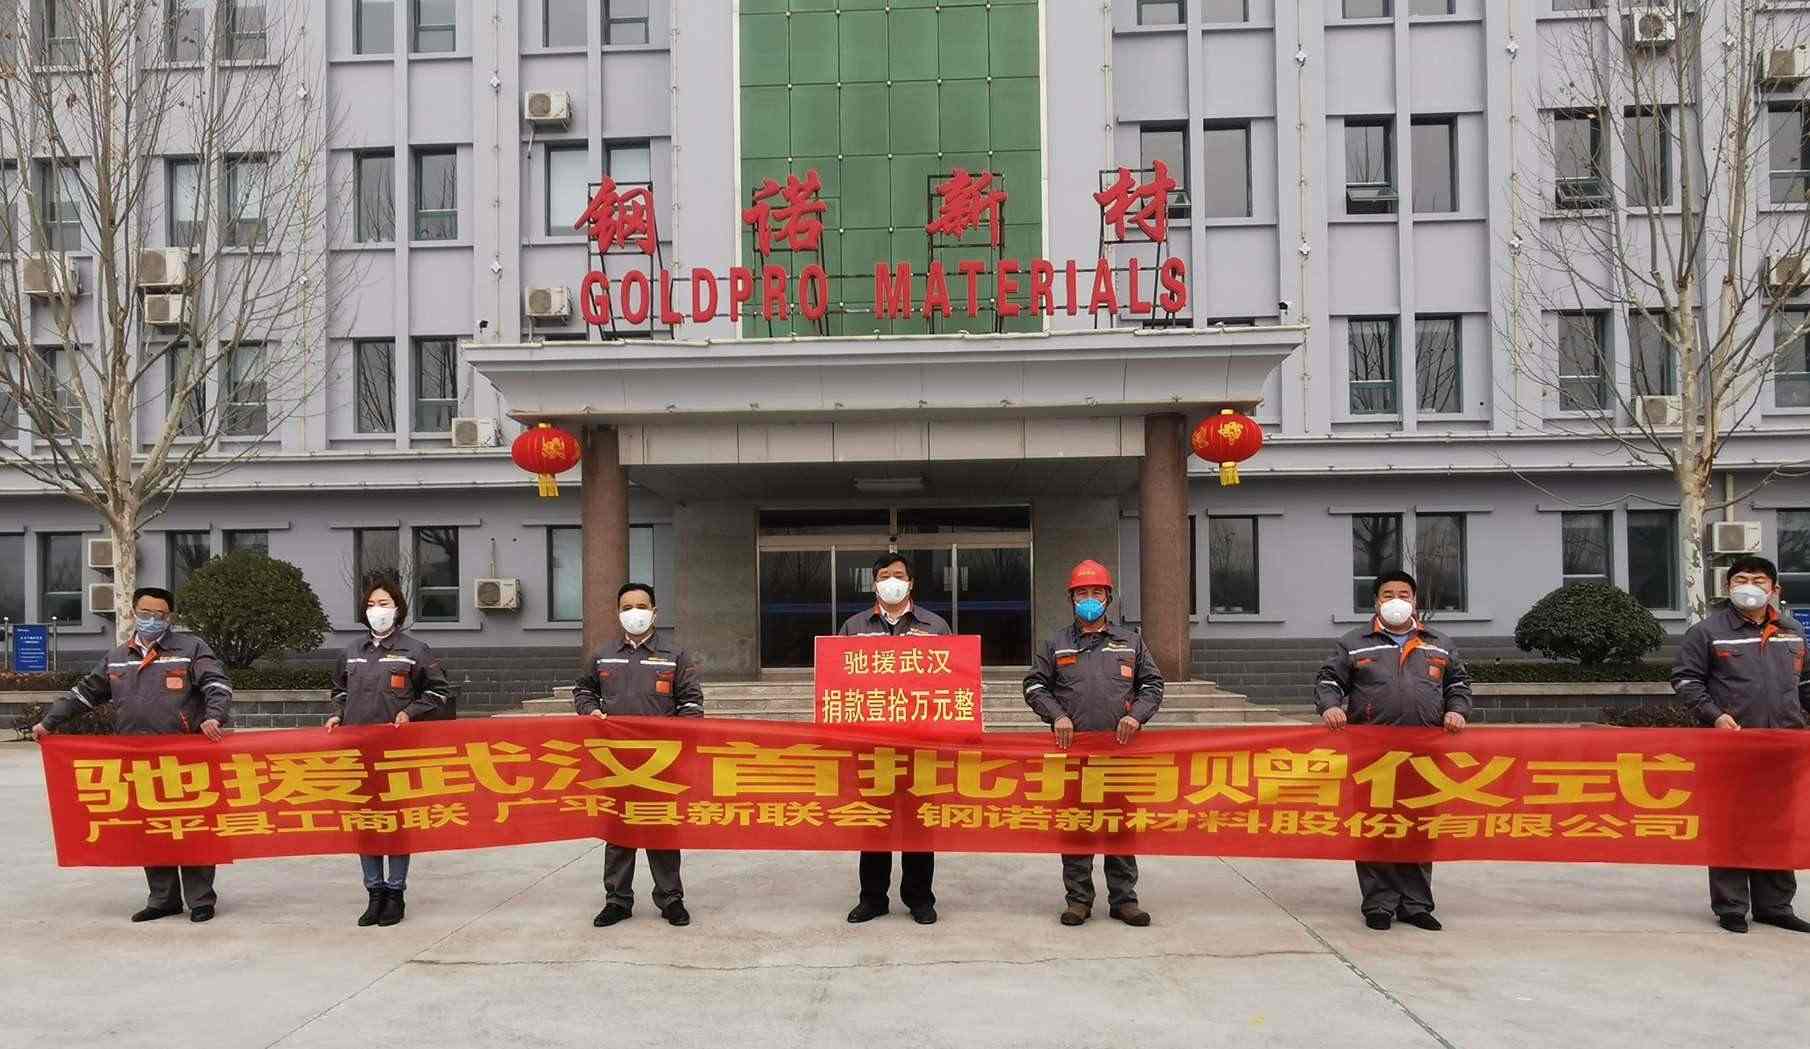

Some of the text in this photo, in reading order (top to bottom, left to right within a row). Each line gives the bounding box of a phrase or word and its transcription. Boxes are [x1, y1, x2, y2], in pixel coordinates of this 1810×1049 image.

[574, 159, 1177, 257] 钢诺新材
[580, 256, 1188, 326] GOLDPRO MATERIALS
[843, 647, 953, 675] 驰援武汉
[821, 687, 976, 724] 捐款壹拾万元整
[73, 739, 1697, 814] 驰援武汉首批捐赠仪式
[86, 797, 1701, 844] 广平县工商联 广平县新联会 钢诺新材料股份有限公司
